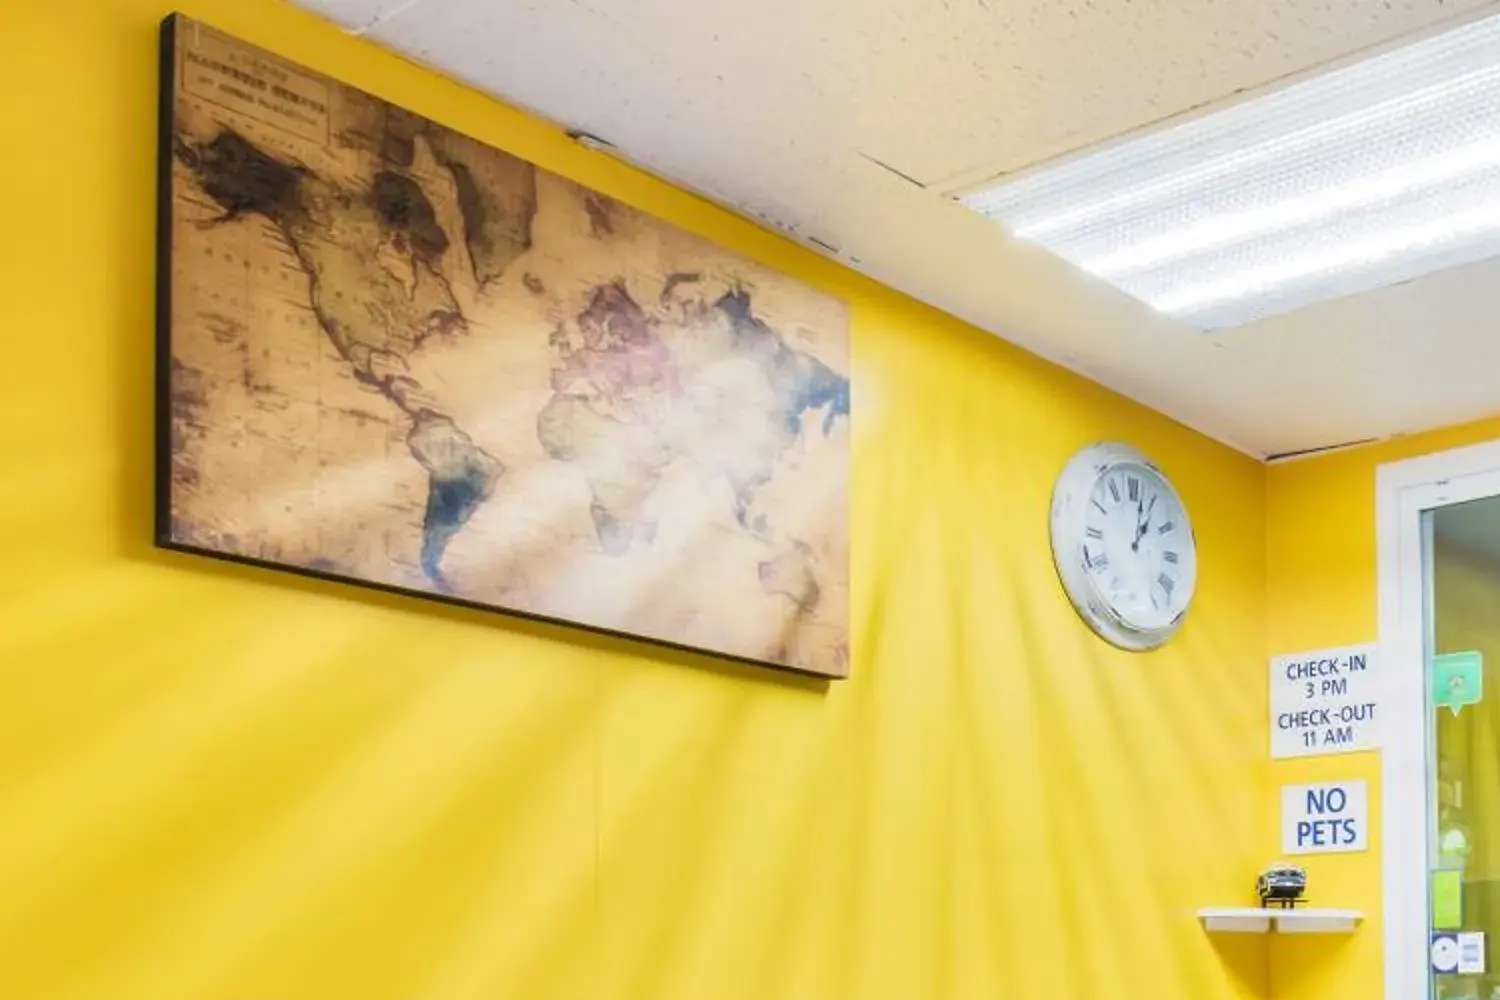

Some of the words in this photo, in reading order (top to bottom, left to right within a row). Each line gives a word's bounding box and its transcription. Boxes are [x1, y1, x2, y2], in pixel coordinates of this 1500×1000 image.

[1286, 654, 1367, 680] CHECK-IN
[1306, 682, 1315, 698] 3
[1321, 678, 1347, 697] PM
[1278, 703, 1376, 730] CHECK-OUT
[1302, 731, 1316, 747] 11
[1323, 727, 1353, 745] AM
[1306, 787, 1347, 815] NO
[1297, 819, 1357, 847] PETS
